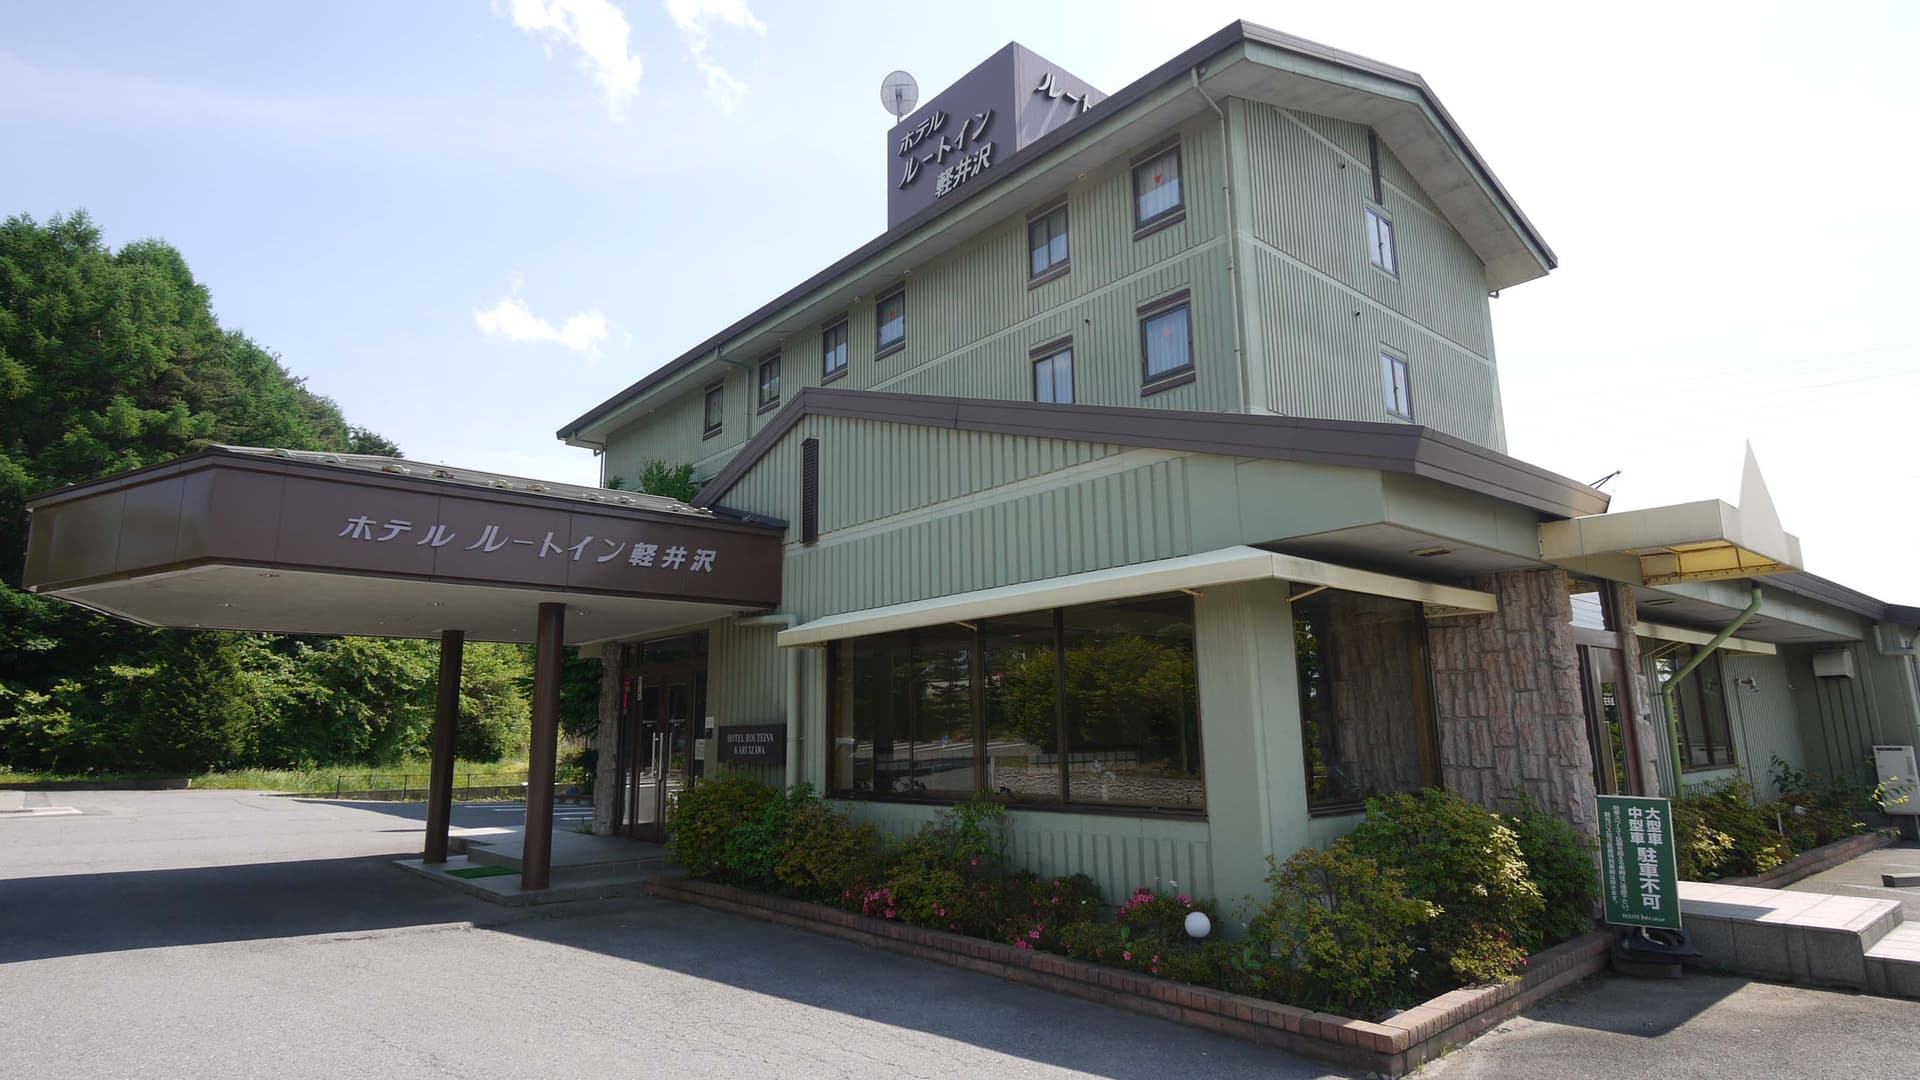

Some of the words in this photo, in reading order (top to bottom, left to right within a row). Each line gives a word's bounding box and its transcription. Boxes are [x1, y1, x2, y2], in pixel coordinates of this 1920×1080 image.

[898, 110, 948, 156] ホテル
[898, 107, 995, 190] ルートイン
[934, 142, 993, 199] 軽井沢
[1627, 806, 1645, 845] 中型車
[1644, 807, 1664, 846] 大型車
[1637, 846, 1661, 911] 駐車不可
